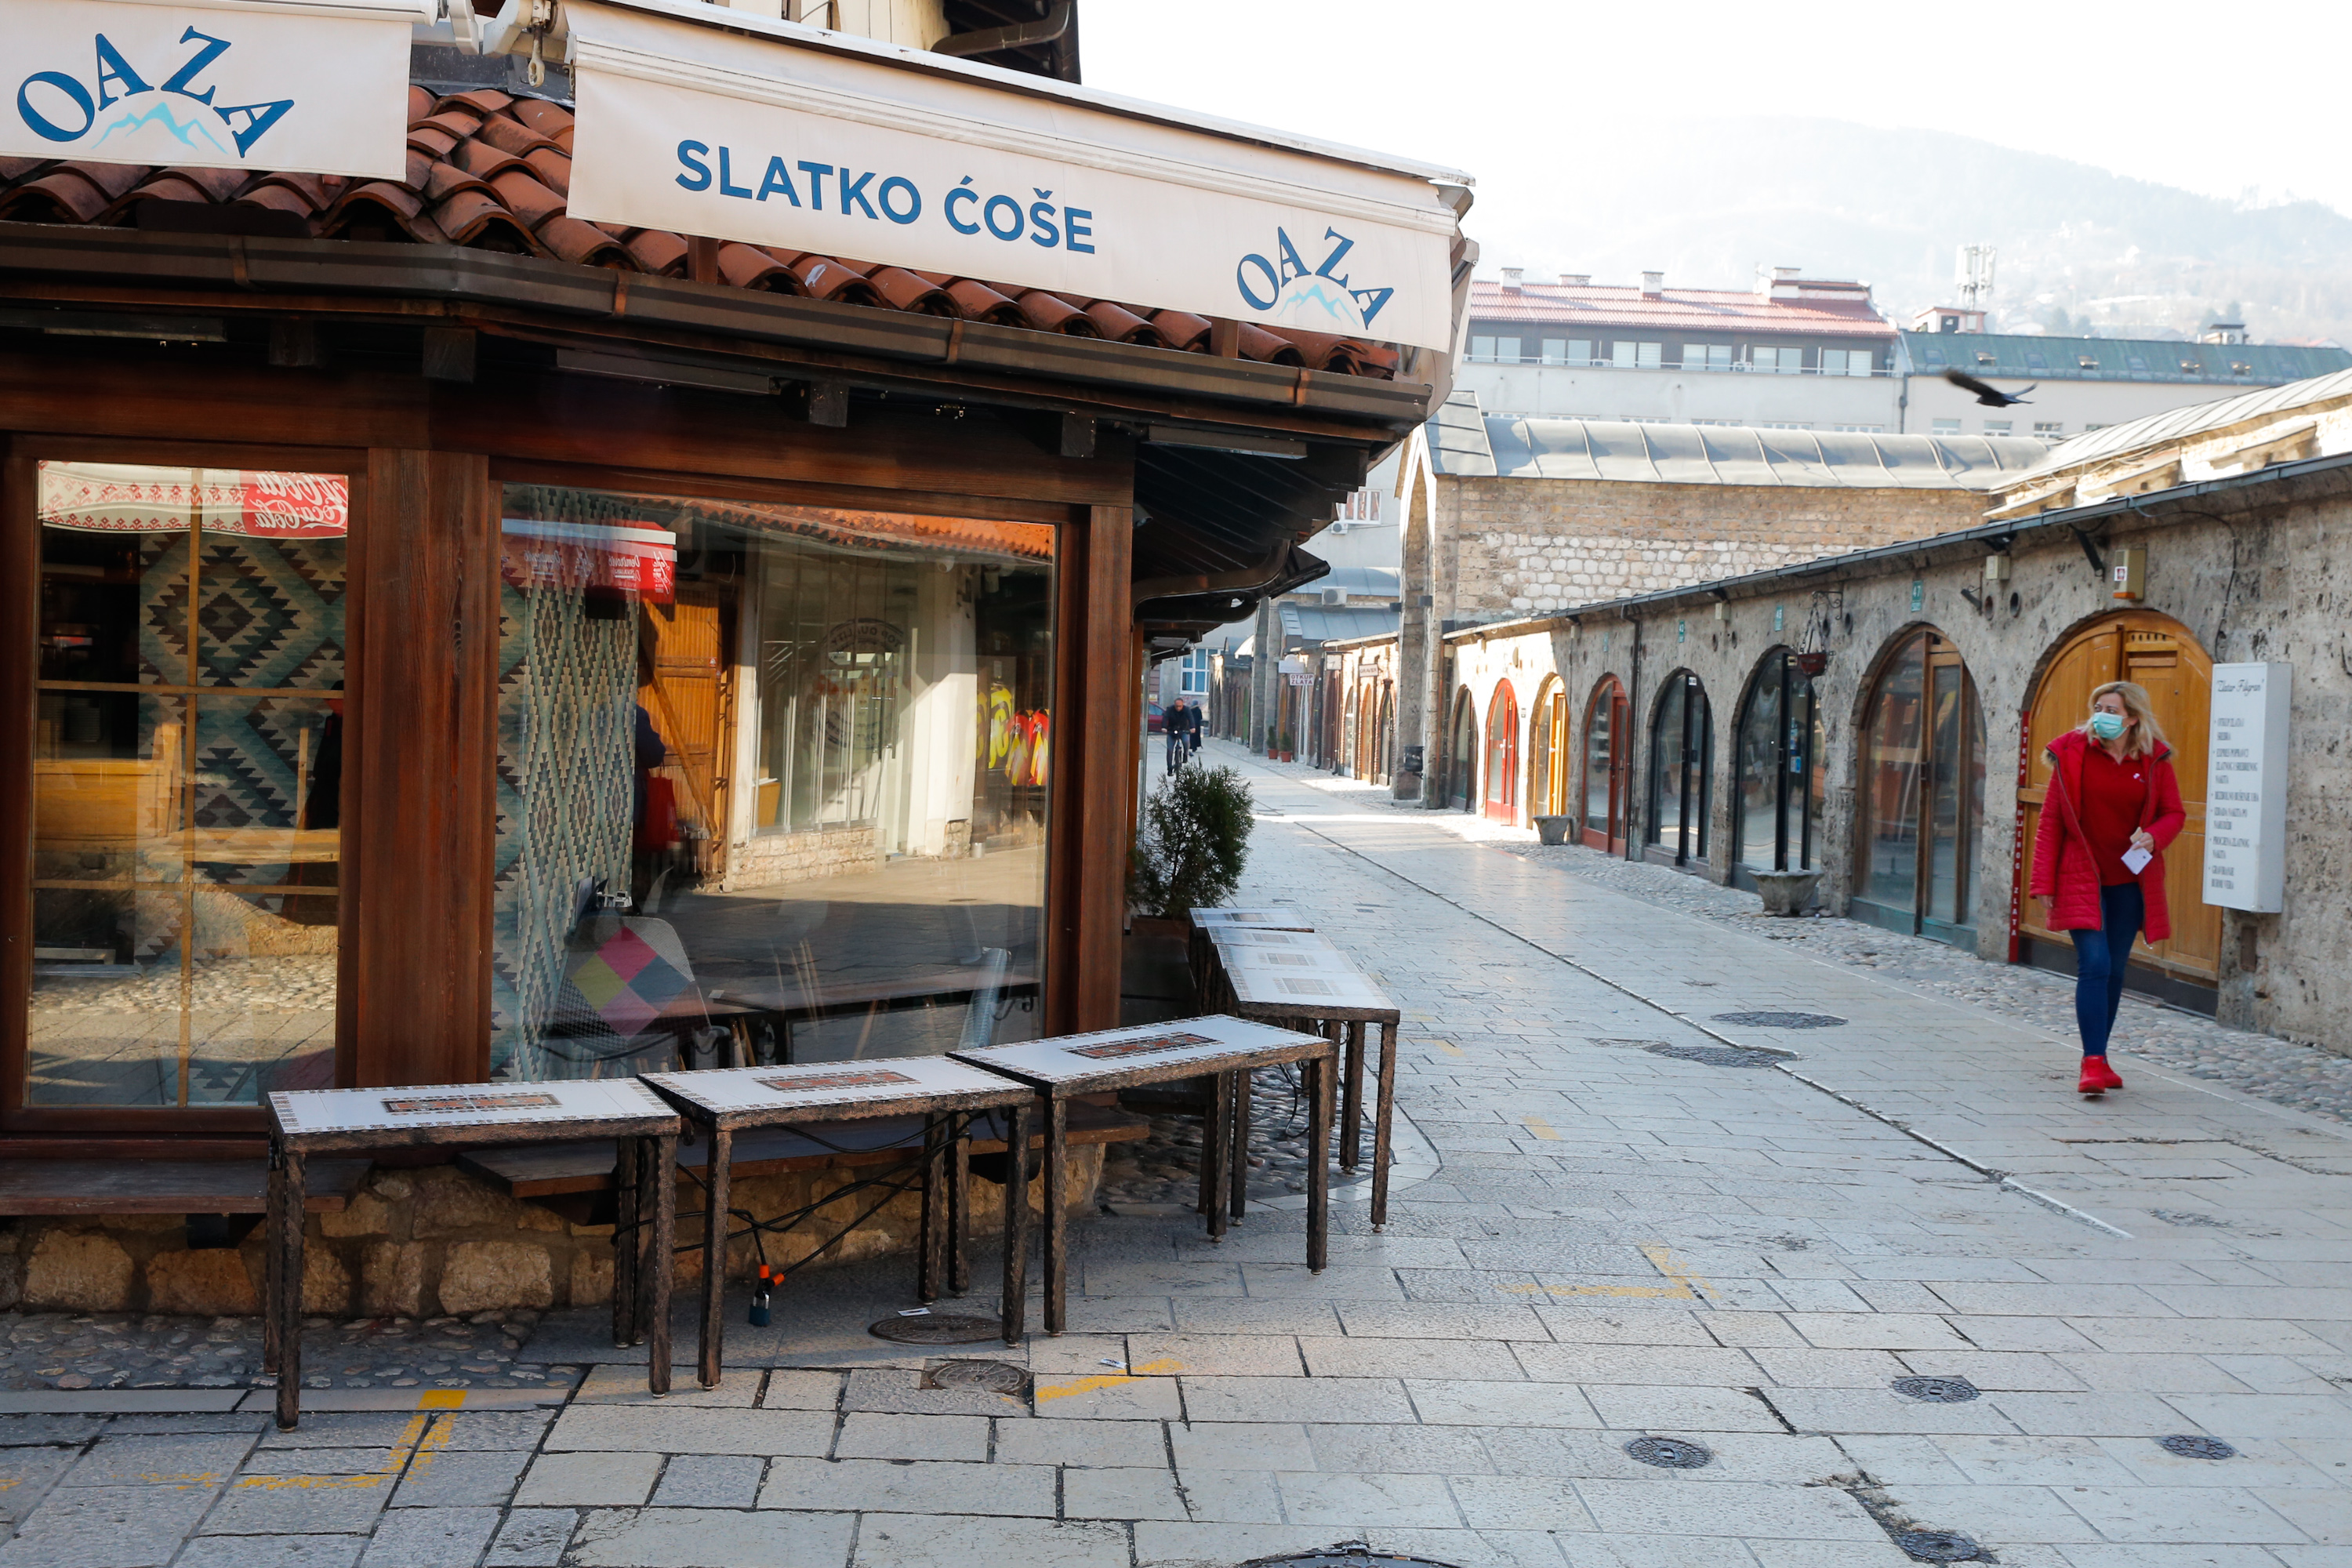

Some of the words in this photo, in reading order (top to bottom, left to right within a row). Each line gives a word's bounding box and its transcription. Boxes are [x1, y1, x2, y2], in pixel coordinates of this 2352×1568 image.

[17, 25, 294, 158] OAZA
[675, 140, 922, 225] SLATKO
[944, 176, 1095, 254] ĆOŠE
[1236, 225, 1394, 330] OAZA
[1913, 586, 1921, 597] 47
